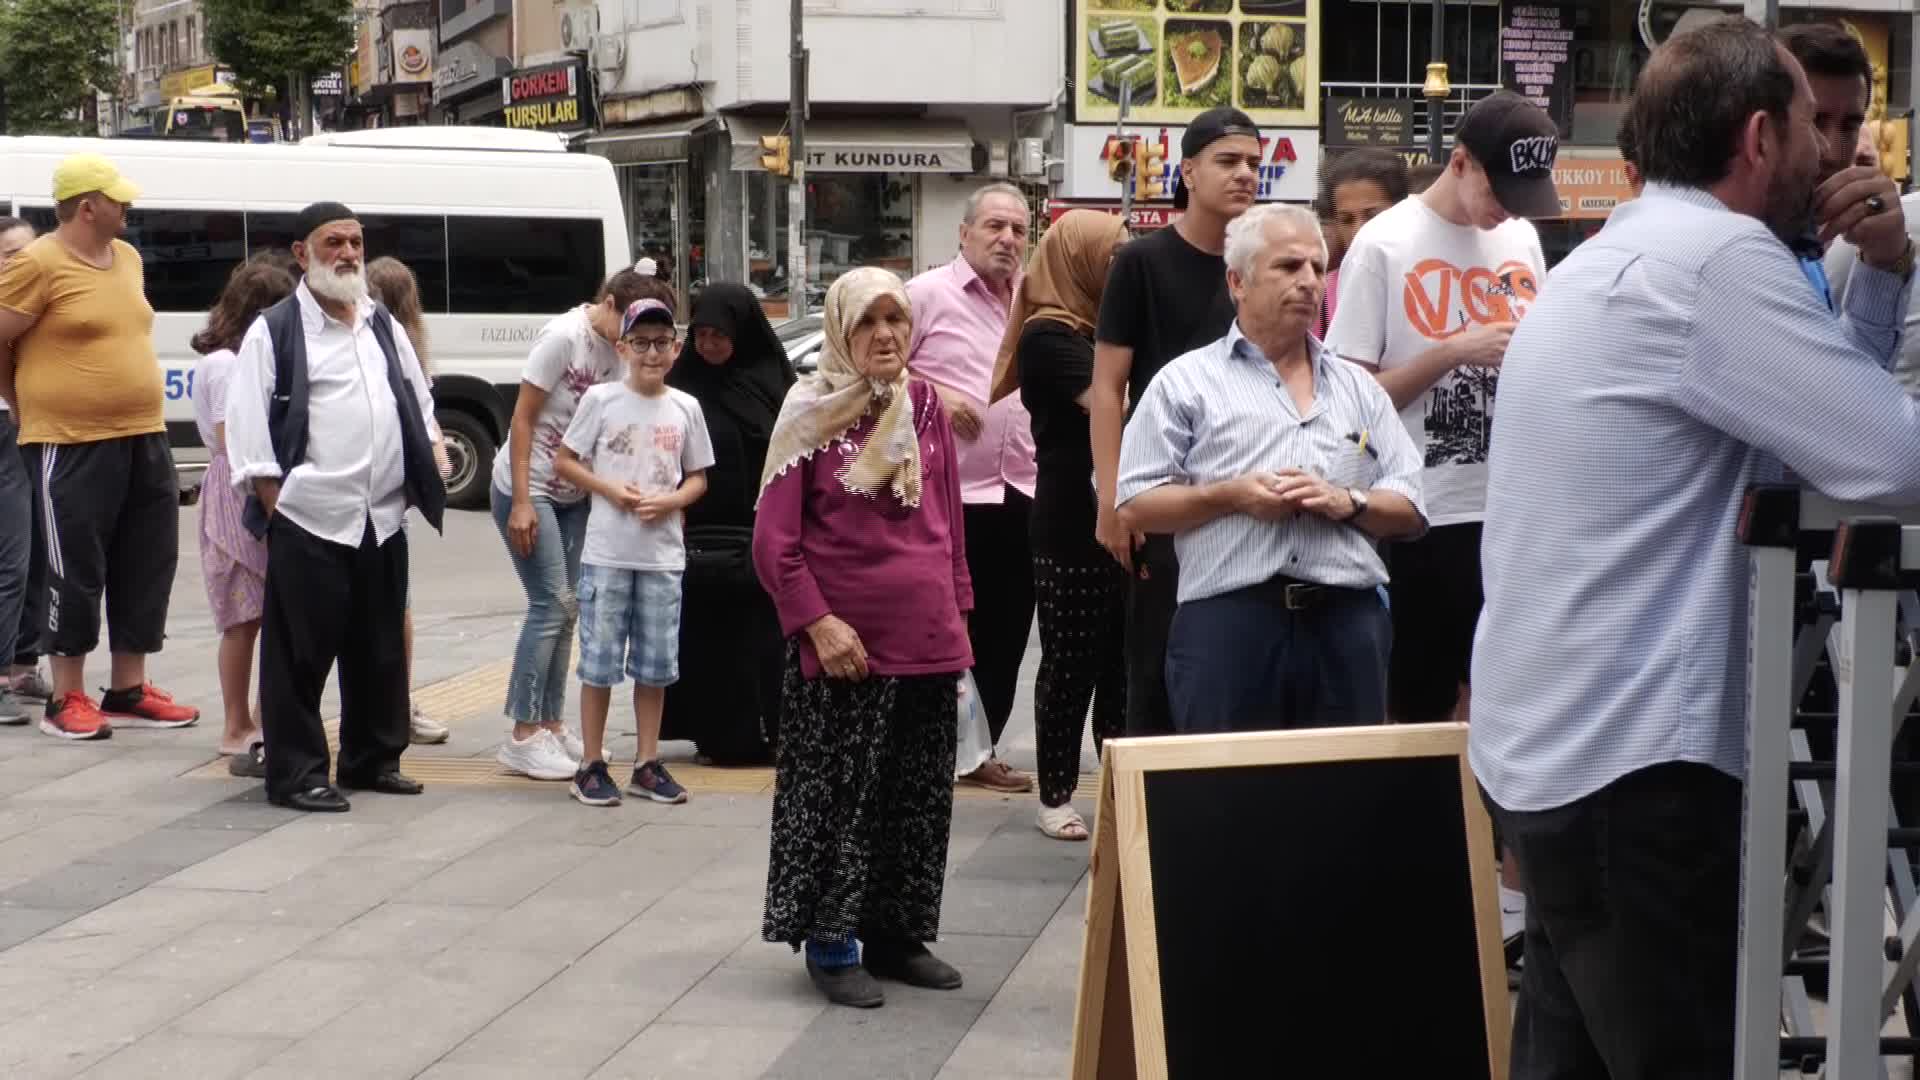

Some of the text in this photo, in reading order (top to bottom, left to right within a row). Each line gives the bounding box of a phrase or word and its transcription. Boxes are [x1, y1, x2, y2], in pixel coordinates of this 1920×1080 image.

[806, 152, 942, 167] İT KUNDURA
[1129, 209, 1163, 225] STA
